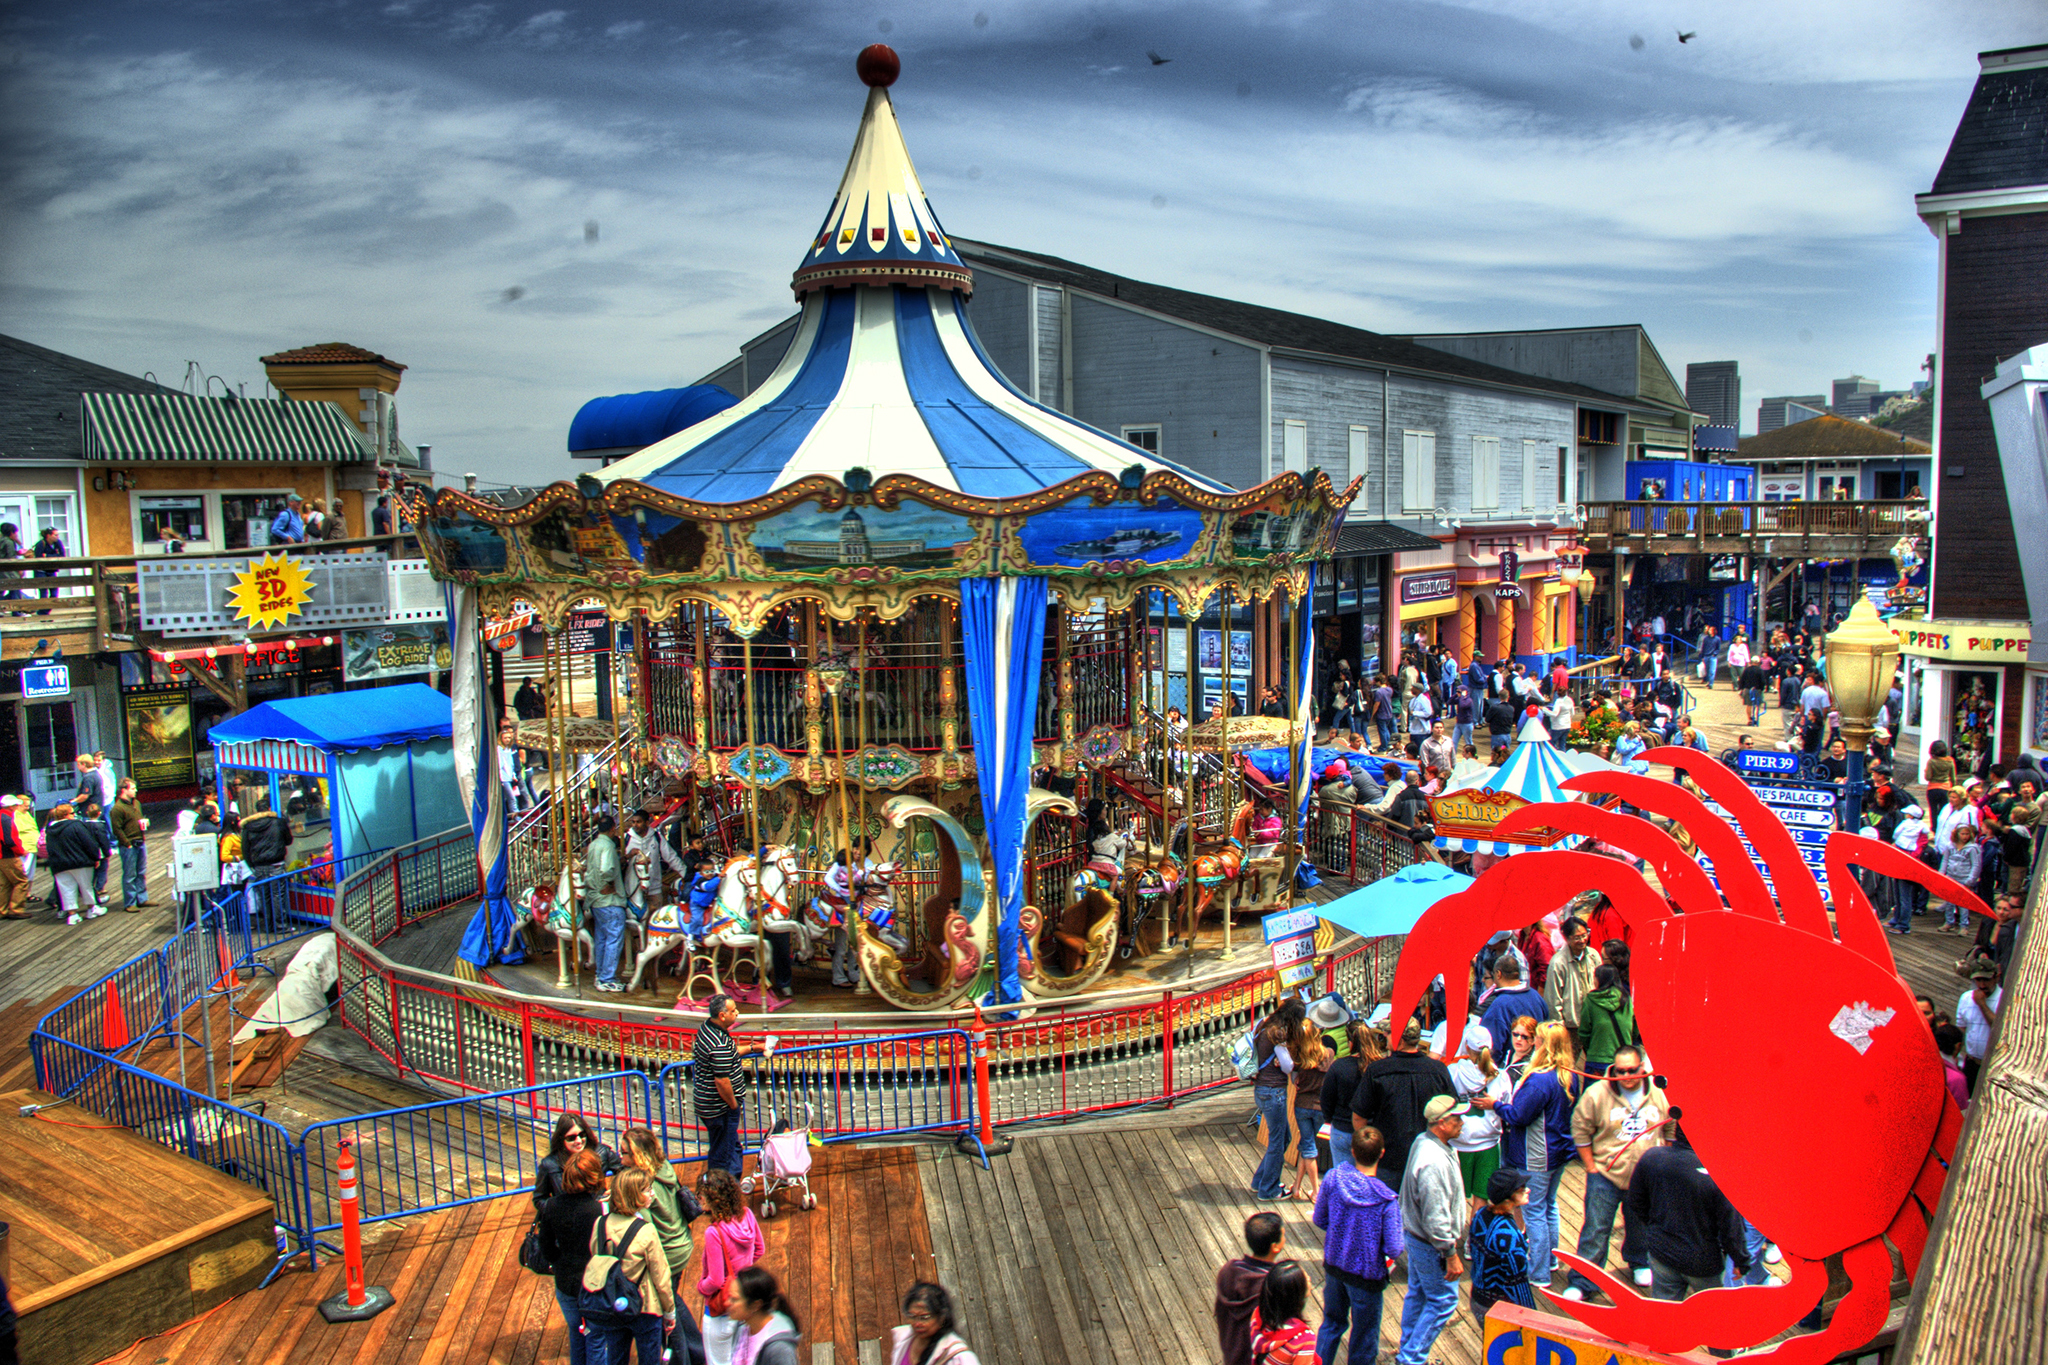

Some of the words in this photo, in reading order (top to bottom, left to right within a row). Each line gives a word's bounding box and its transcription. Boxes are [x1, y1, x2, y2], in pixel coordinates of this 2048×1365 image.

[255, 566, 280, 581] NEW
[1504, 553, 1512, 581] KRAZY
[254, 579, 287, 601] 3D
[1494, 588, 1521, 597] KAPS
[259, 596, 294, 613] RIDES
[497, 634, 517, 649] 4D
[381, 656, 401, 667] LOG
[404, 653, 429, 663] RIDE!
[28, 686, 67, 696] Restrooms
[1744, 755, 1777, 768] PIER
[1777, 758, 1794, 769] 39
[1778, 790, 1819, 803] PALACE
[1779, 810, 1806, 822] CAFE
